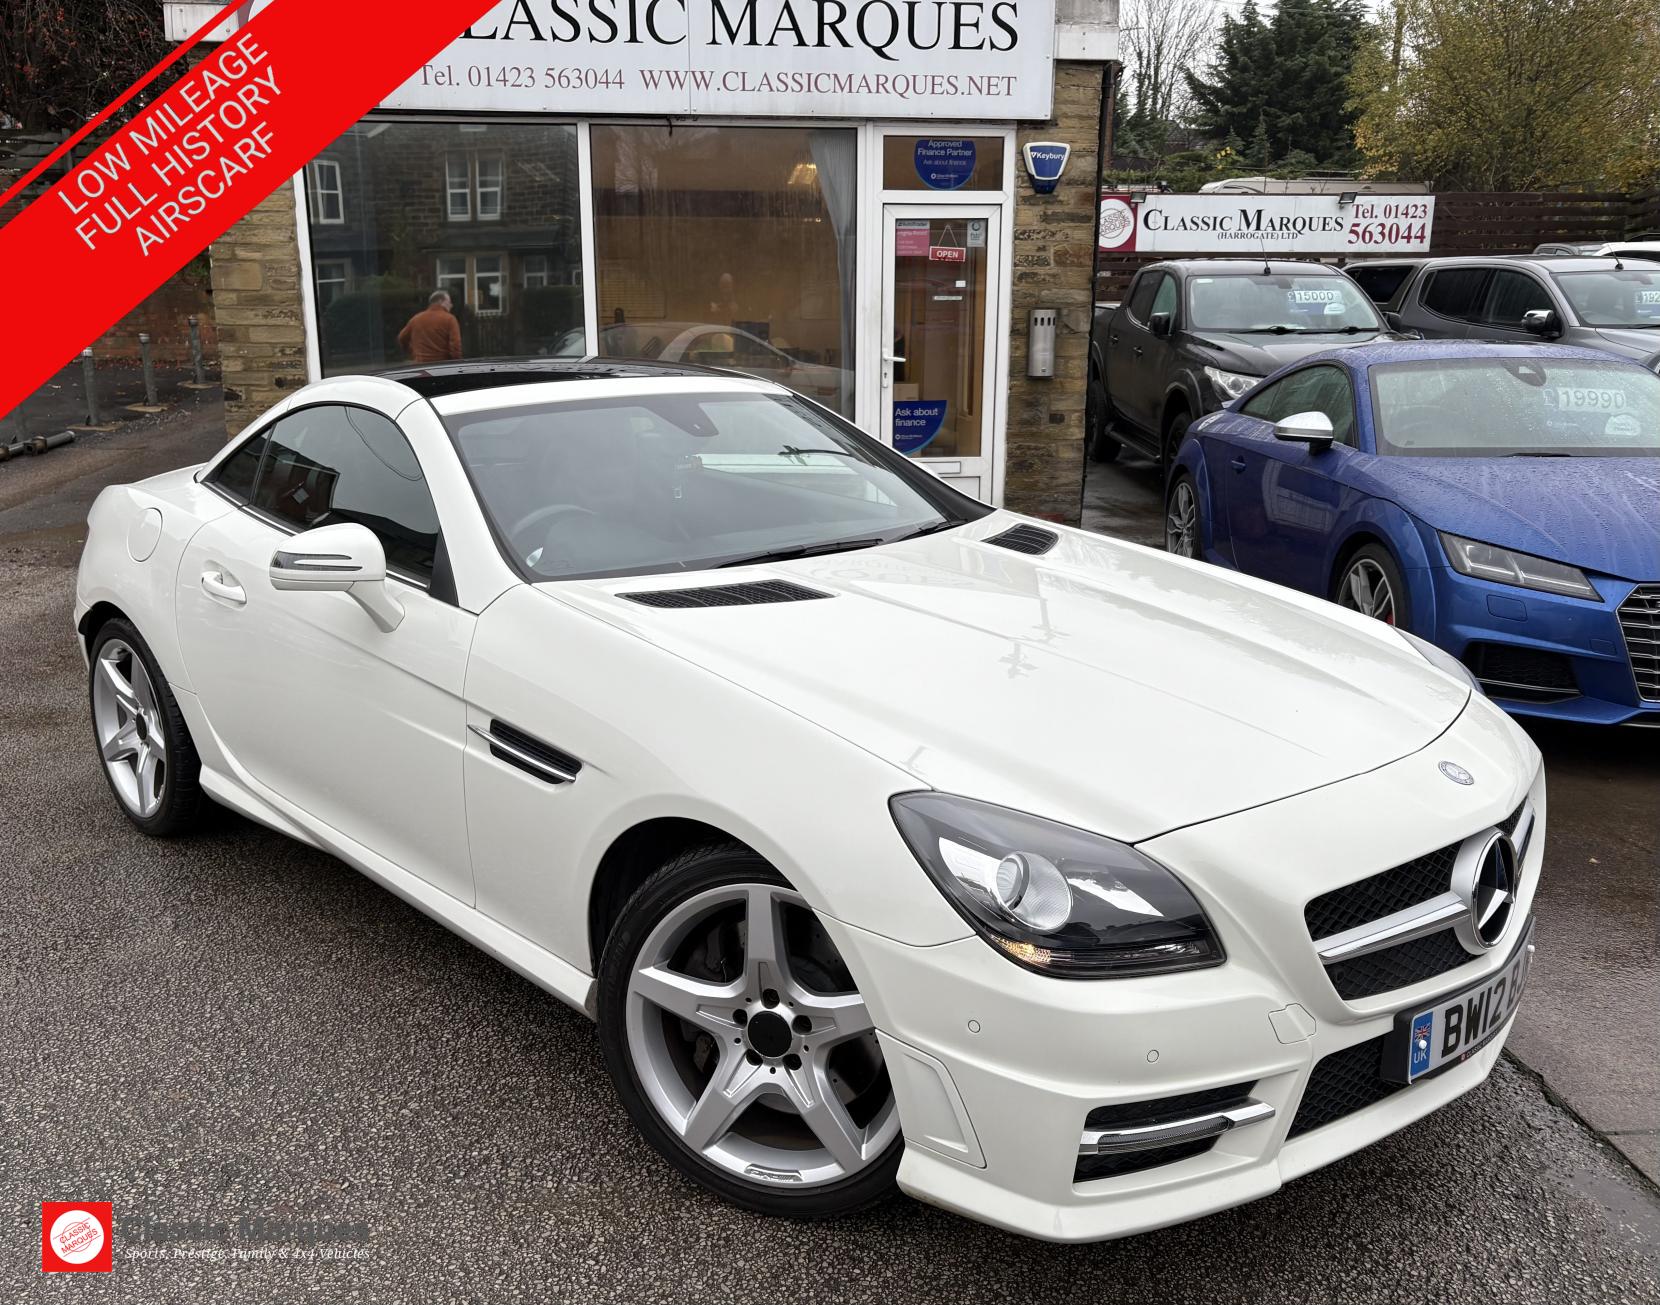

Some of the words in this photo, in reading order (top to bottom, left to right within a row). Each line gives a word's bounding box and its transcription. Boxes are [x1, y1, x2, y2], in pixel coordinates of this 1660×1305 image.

[459, 0, 687, 45] ASSIC
[706, 0, 1019, 61] MARQUES
[420, 64, 460, 87] Tel.
[468, 65, 536, 88] 01423
[544, 67, 625, 90] 563044
[639, 68, 1018, 98] WWW.CLASSICMARQUES.NET
[928, 139, 962, 148] Approved
[917, 148, 946, 156] Finance
[1036, 152, 1065, 161] Keybury
[1352, 204, 1378, 219] Tel.
[1383, 203, 1428, 219] 01423
[1217, 231, 1280, 241] (HARROGATE)
[1281, 231, 1298, 240] LTD
[1347, 222, 1427, 245] 563044
[936, 250, 959, 259] OPEN
[895, 407, 911, 417] Ask
[913, 407, 938, 416] about
[895, 418, 926, 427] finance
[1413, 1051, 1427, 1064] UK
